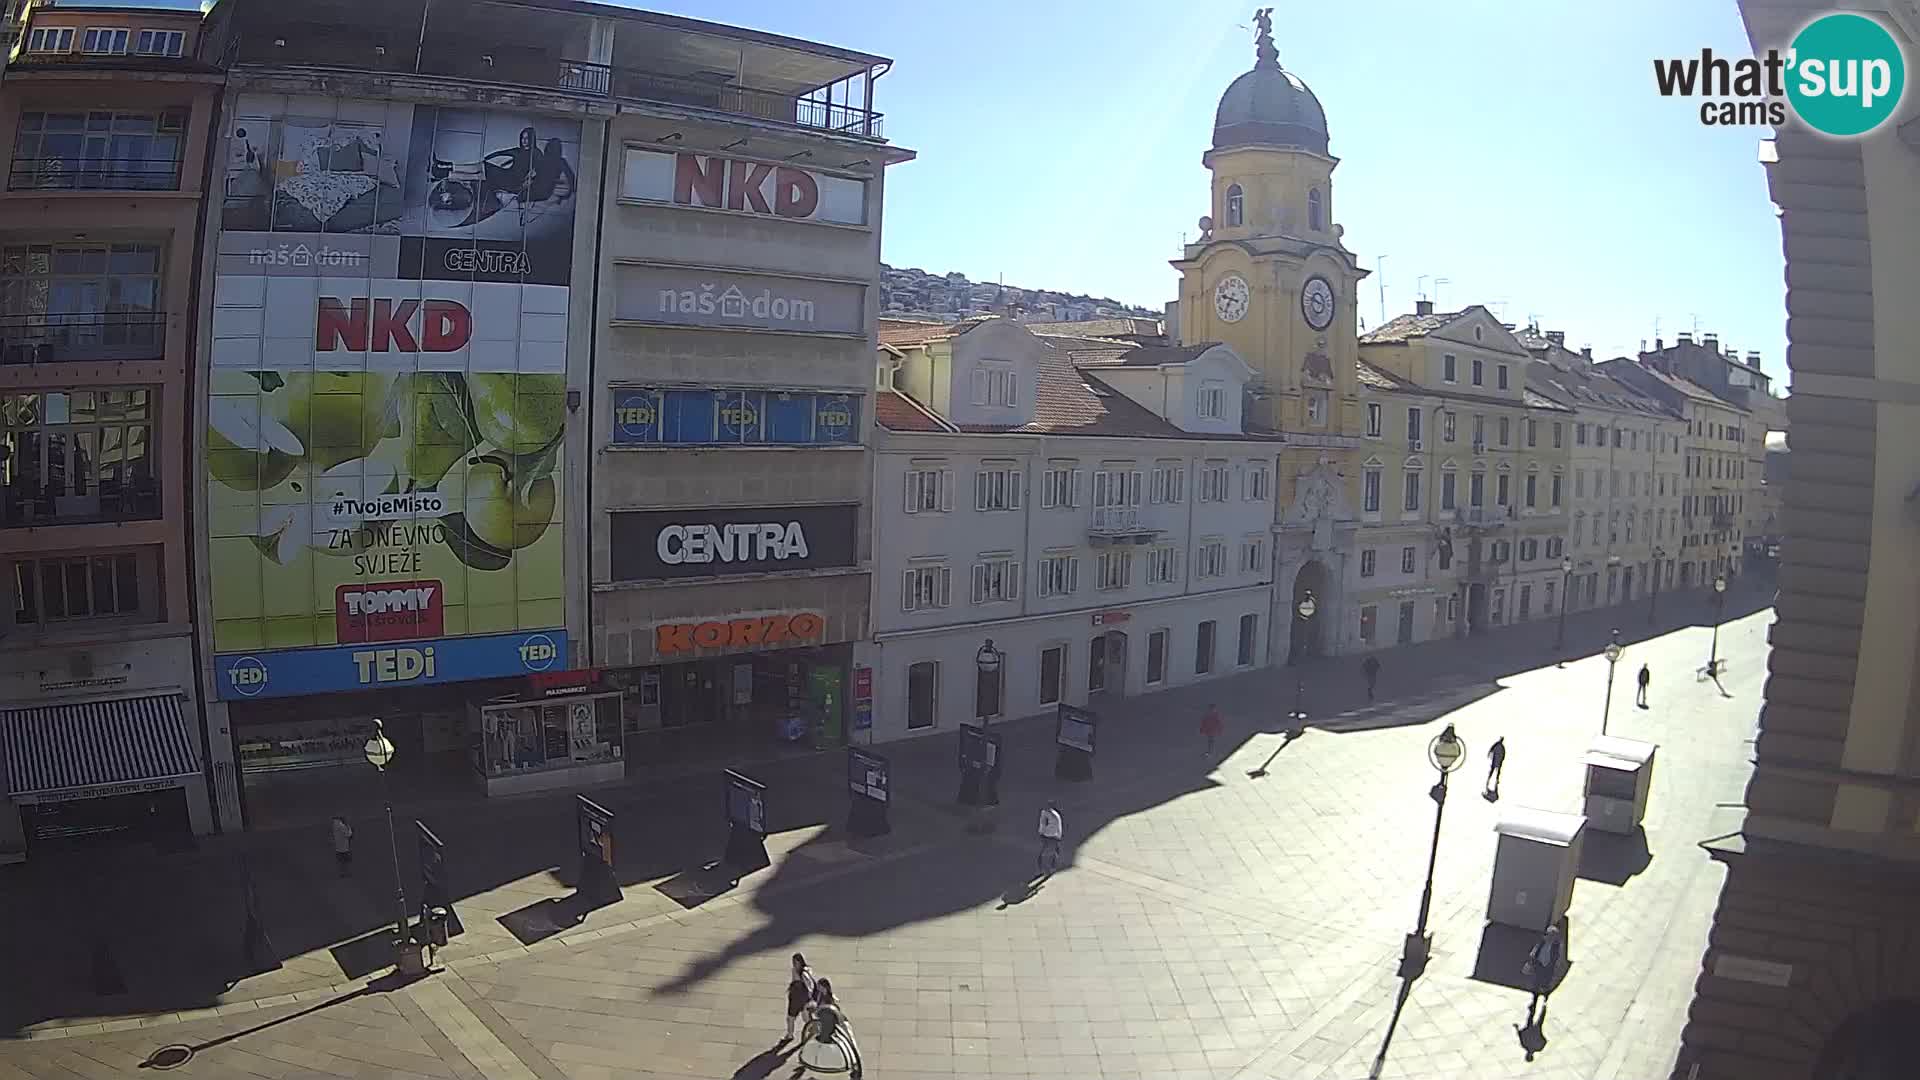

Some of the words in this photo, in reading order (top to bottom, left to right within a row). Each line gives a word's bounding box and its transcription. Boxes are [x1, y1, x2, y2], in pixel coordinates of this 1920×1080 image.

[674, 152, 819, 218] NKD
[249, 243, 289, 266] naš
[314, 245, 361, 267] dom
[443, 247, 531, 276] CENTRA
[659, 282, 716, 315] naš
[751, 288, 816, 323] dom
[316, 296, 473, 353] NKD
[615, 407, 657, 426] TEDi
[332, 496, 442, 517] #TvojeMisto
[327, 528, 353, 550] ZA
[361, 523, 447, 548] DNEVNO
[656, 521, 809, 565] CENTRA
[353, 547, 423, 576] SVJEŽE
[343, 587, 436, 615] TOMMY
[655, 612, 824, 656] KORZO
[352, 646, 436, 685] TEDi
[518, 643, 557, 662] TEDi
[228, 667, 269, 686] TEDi
